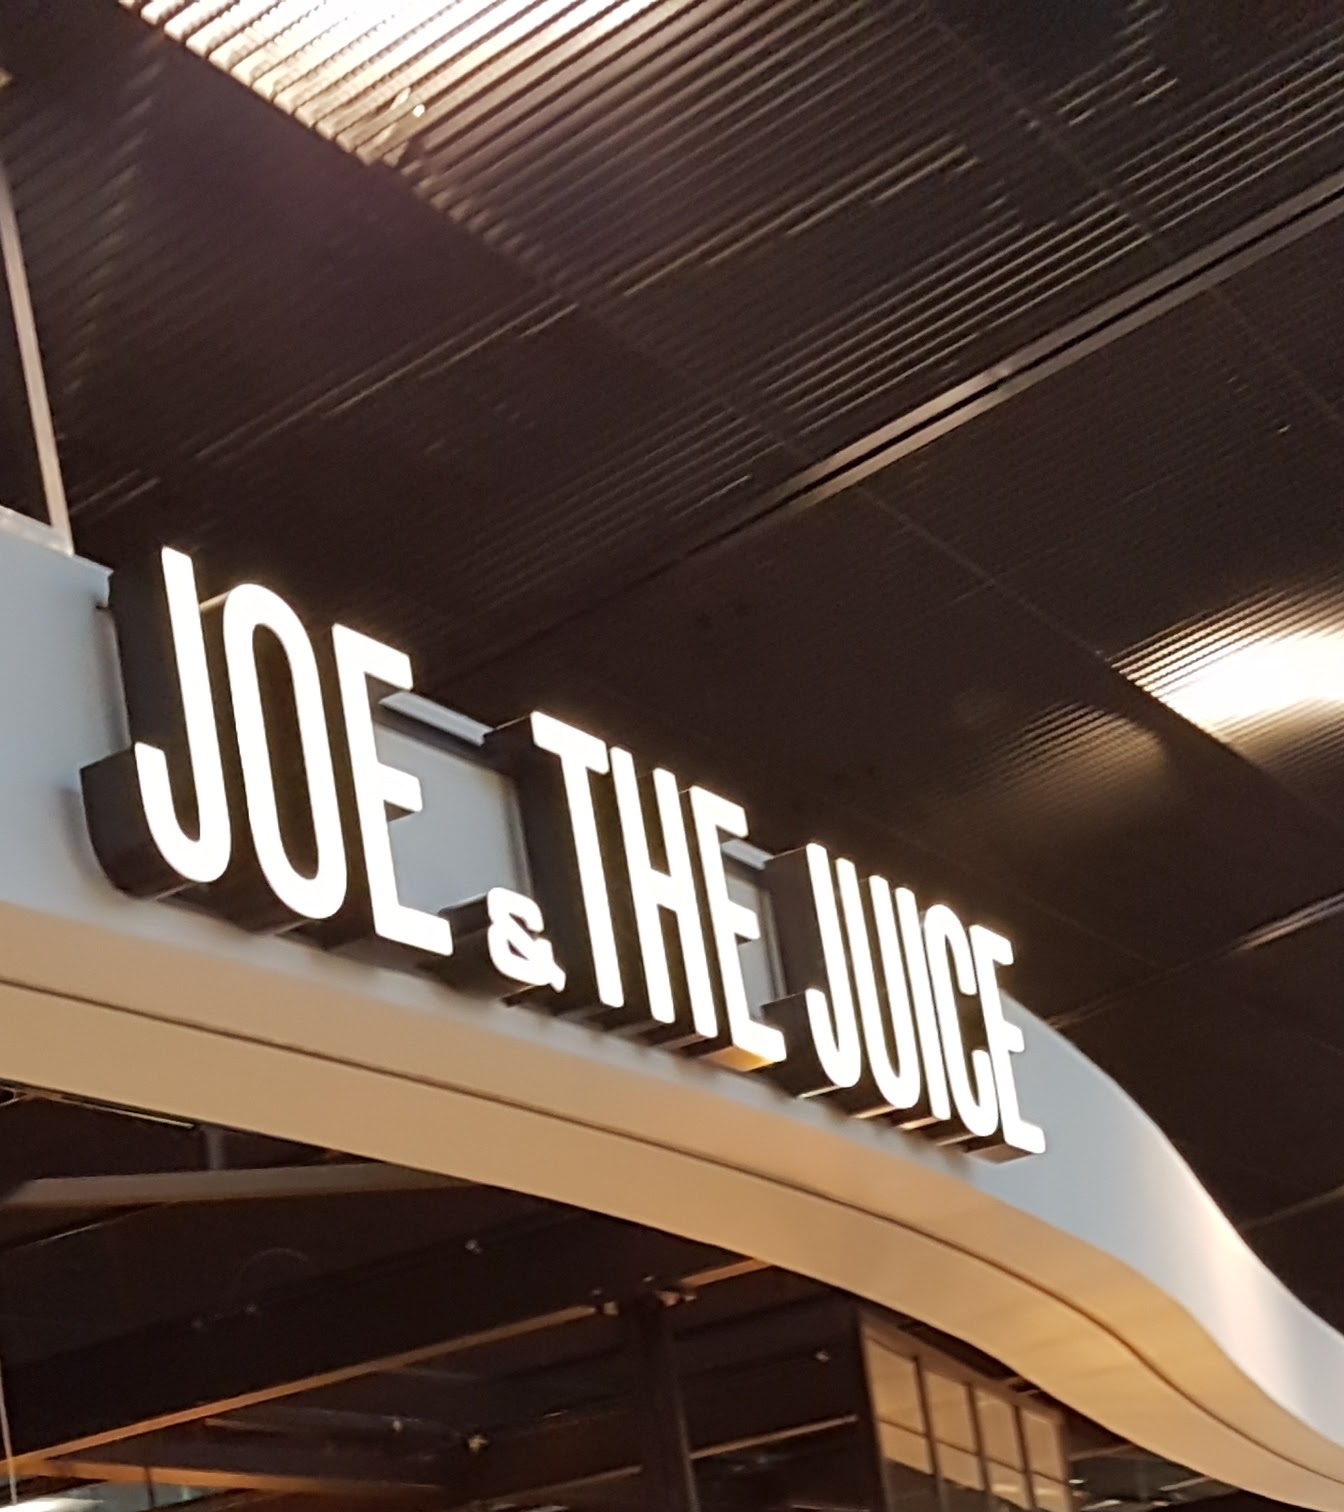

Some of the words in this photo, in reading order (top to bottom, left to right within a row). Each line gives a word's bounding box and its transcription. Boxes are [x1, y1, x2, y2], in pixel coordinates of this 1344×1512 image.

[135, 547, 453, 956] JOE
[487, 887, 565, 991] &
[530, 711, 786, 1064] THE
[805, 843, 1046, 1154] JUICE
